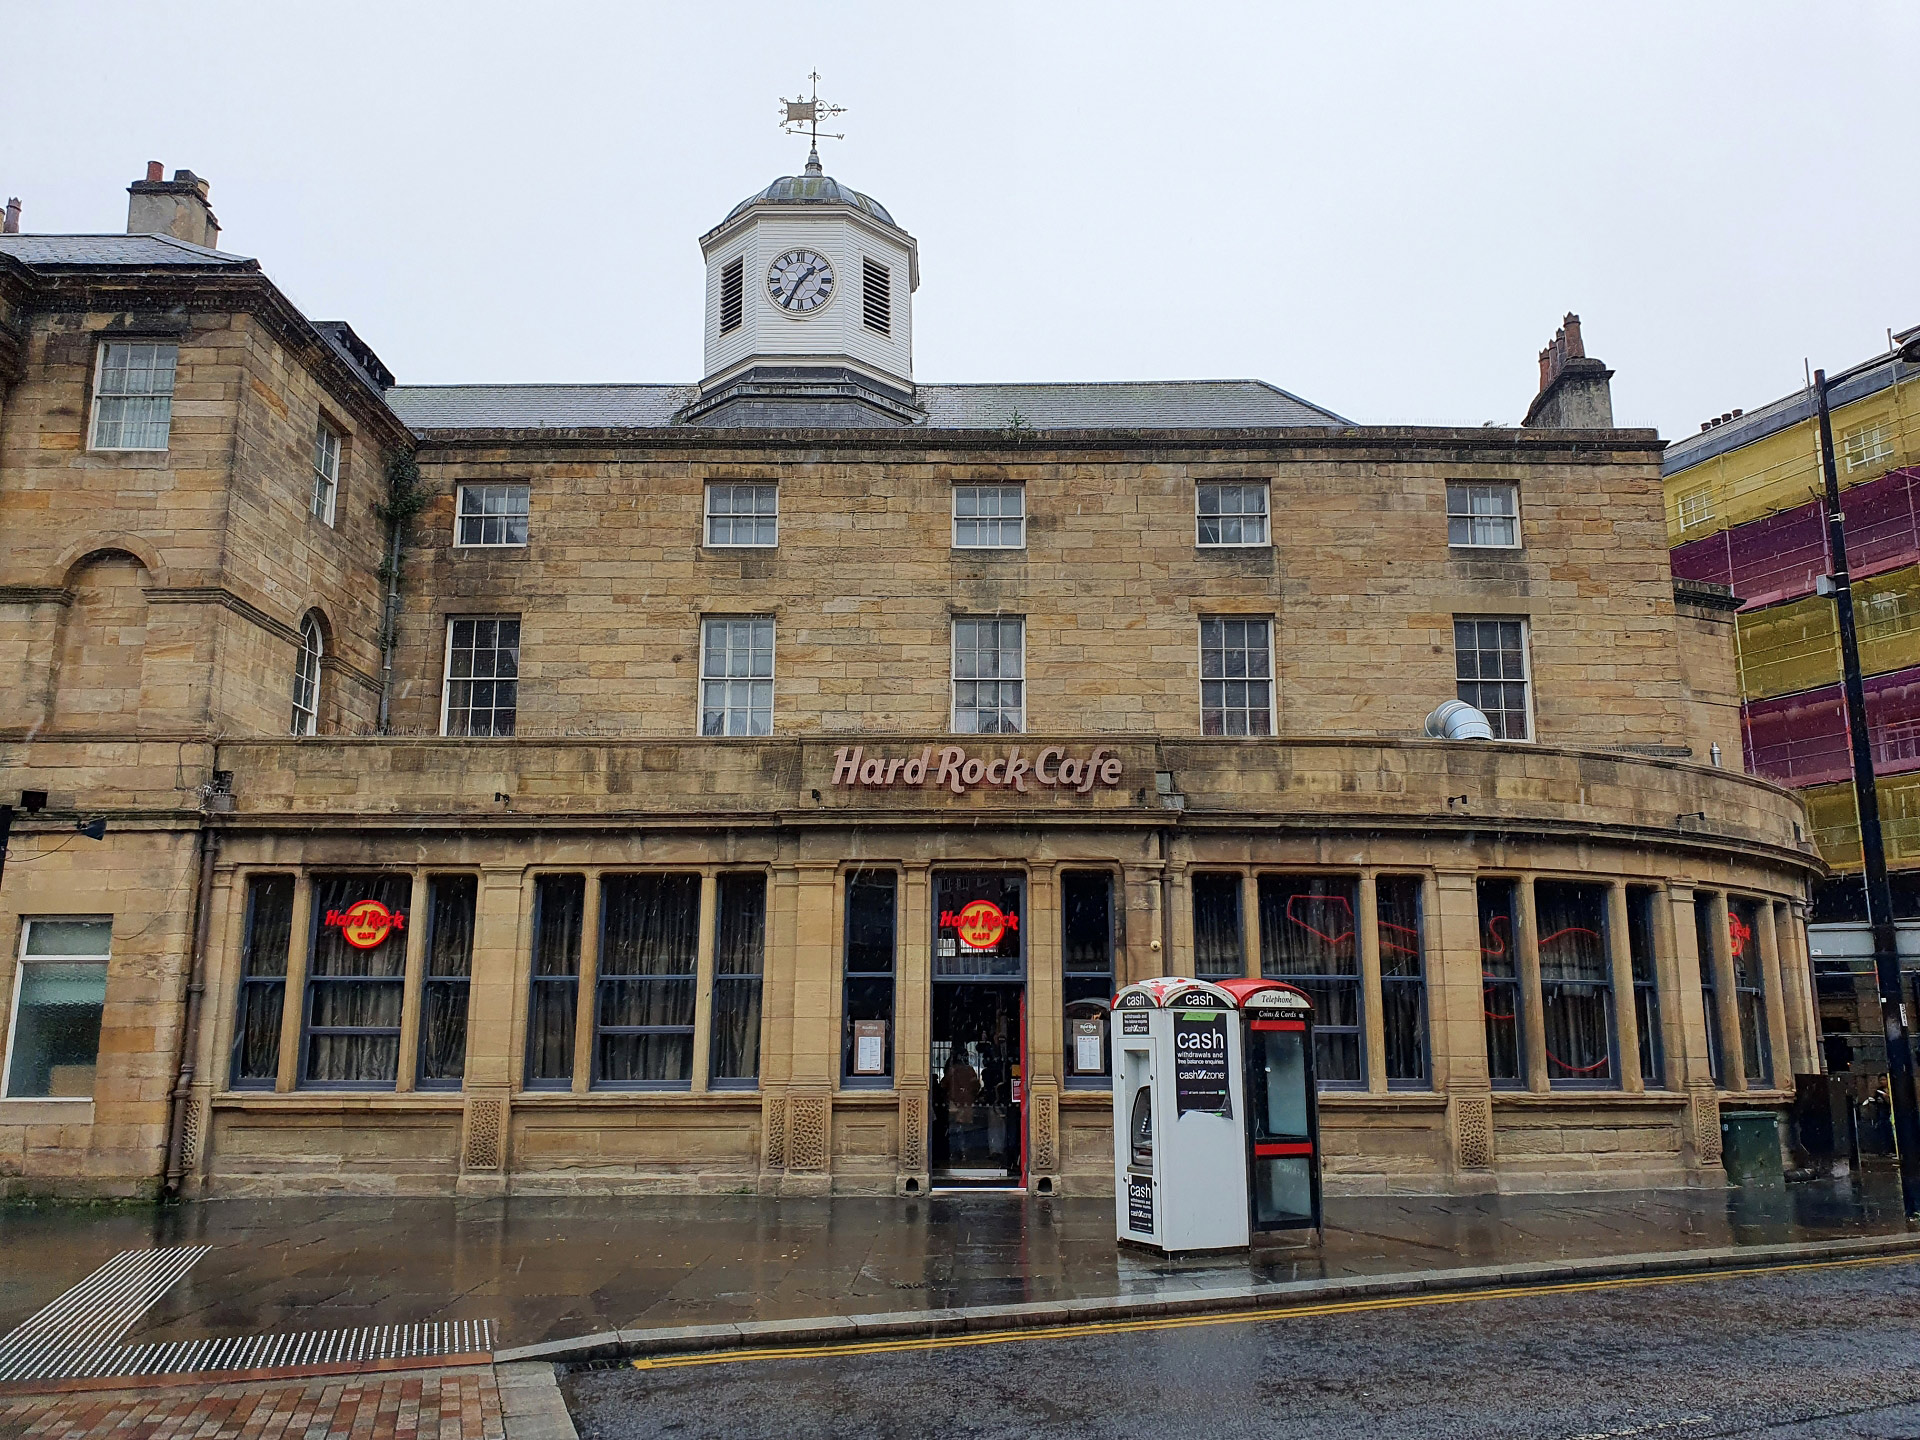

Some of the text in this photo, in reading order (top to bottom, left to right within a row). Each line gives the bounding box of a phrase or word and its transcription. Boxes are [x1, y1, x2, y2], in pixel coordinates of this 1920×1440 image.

[831, 746, 1123, 794] Hard Rock Cafe
[324, 910, 405, 931] Hard Rock
[940, 910, 1019, 931] Hard Rock
[357, 932, 376, 940] CAFE
[972, 932, 990, 940] CAFE
[1126, 992, 1145, 1006] cash
[1186, 992, 1214, 1006] cash
[1261, 995, 1293, 1004] Telephone
[1177, 1028, 1224, 1049] cash
[1130, 1184, 1152, 1198] cash
